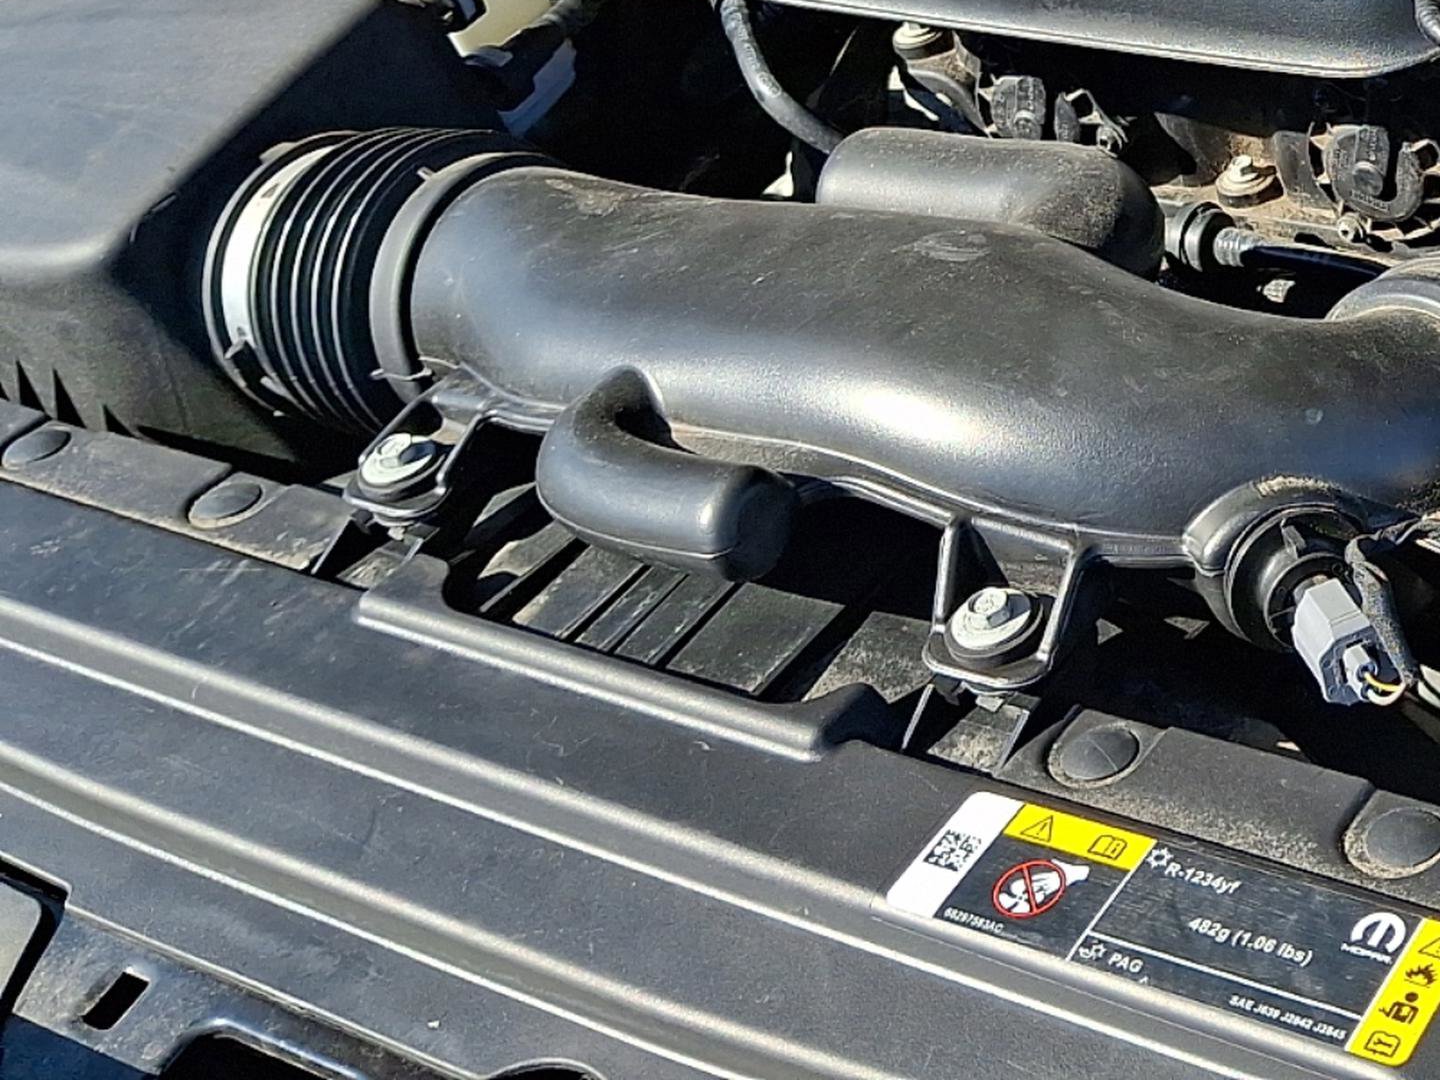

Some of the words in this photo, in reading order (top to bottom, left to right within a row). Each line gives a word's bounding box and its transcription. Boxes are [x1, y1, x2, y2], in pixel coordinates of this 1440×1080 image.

[1164, 862, 1243, 894] R-1234yf
[1188, 918, 1231, 943] 482g
[1231, 929, 1277, 953] (1.06
[1276, 942, 1313, 968] lbs)
[1108, 952, 1144, 973] PAG
[1229, 995, 1255, 1011] SAE
